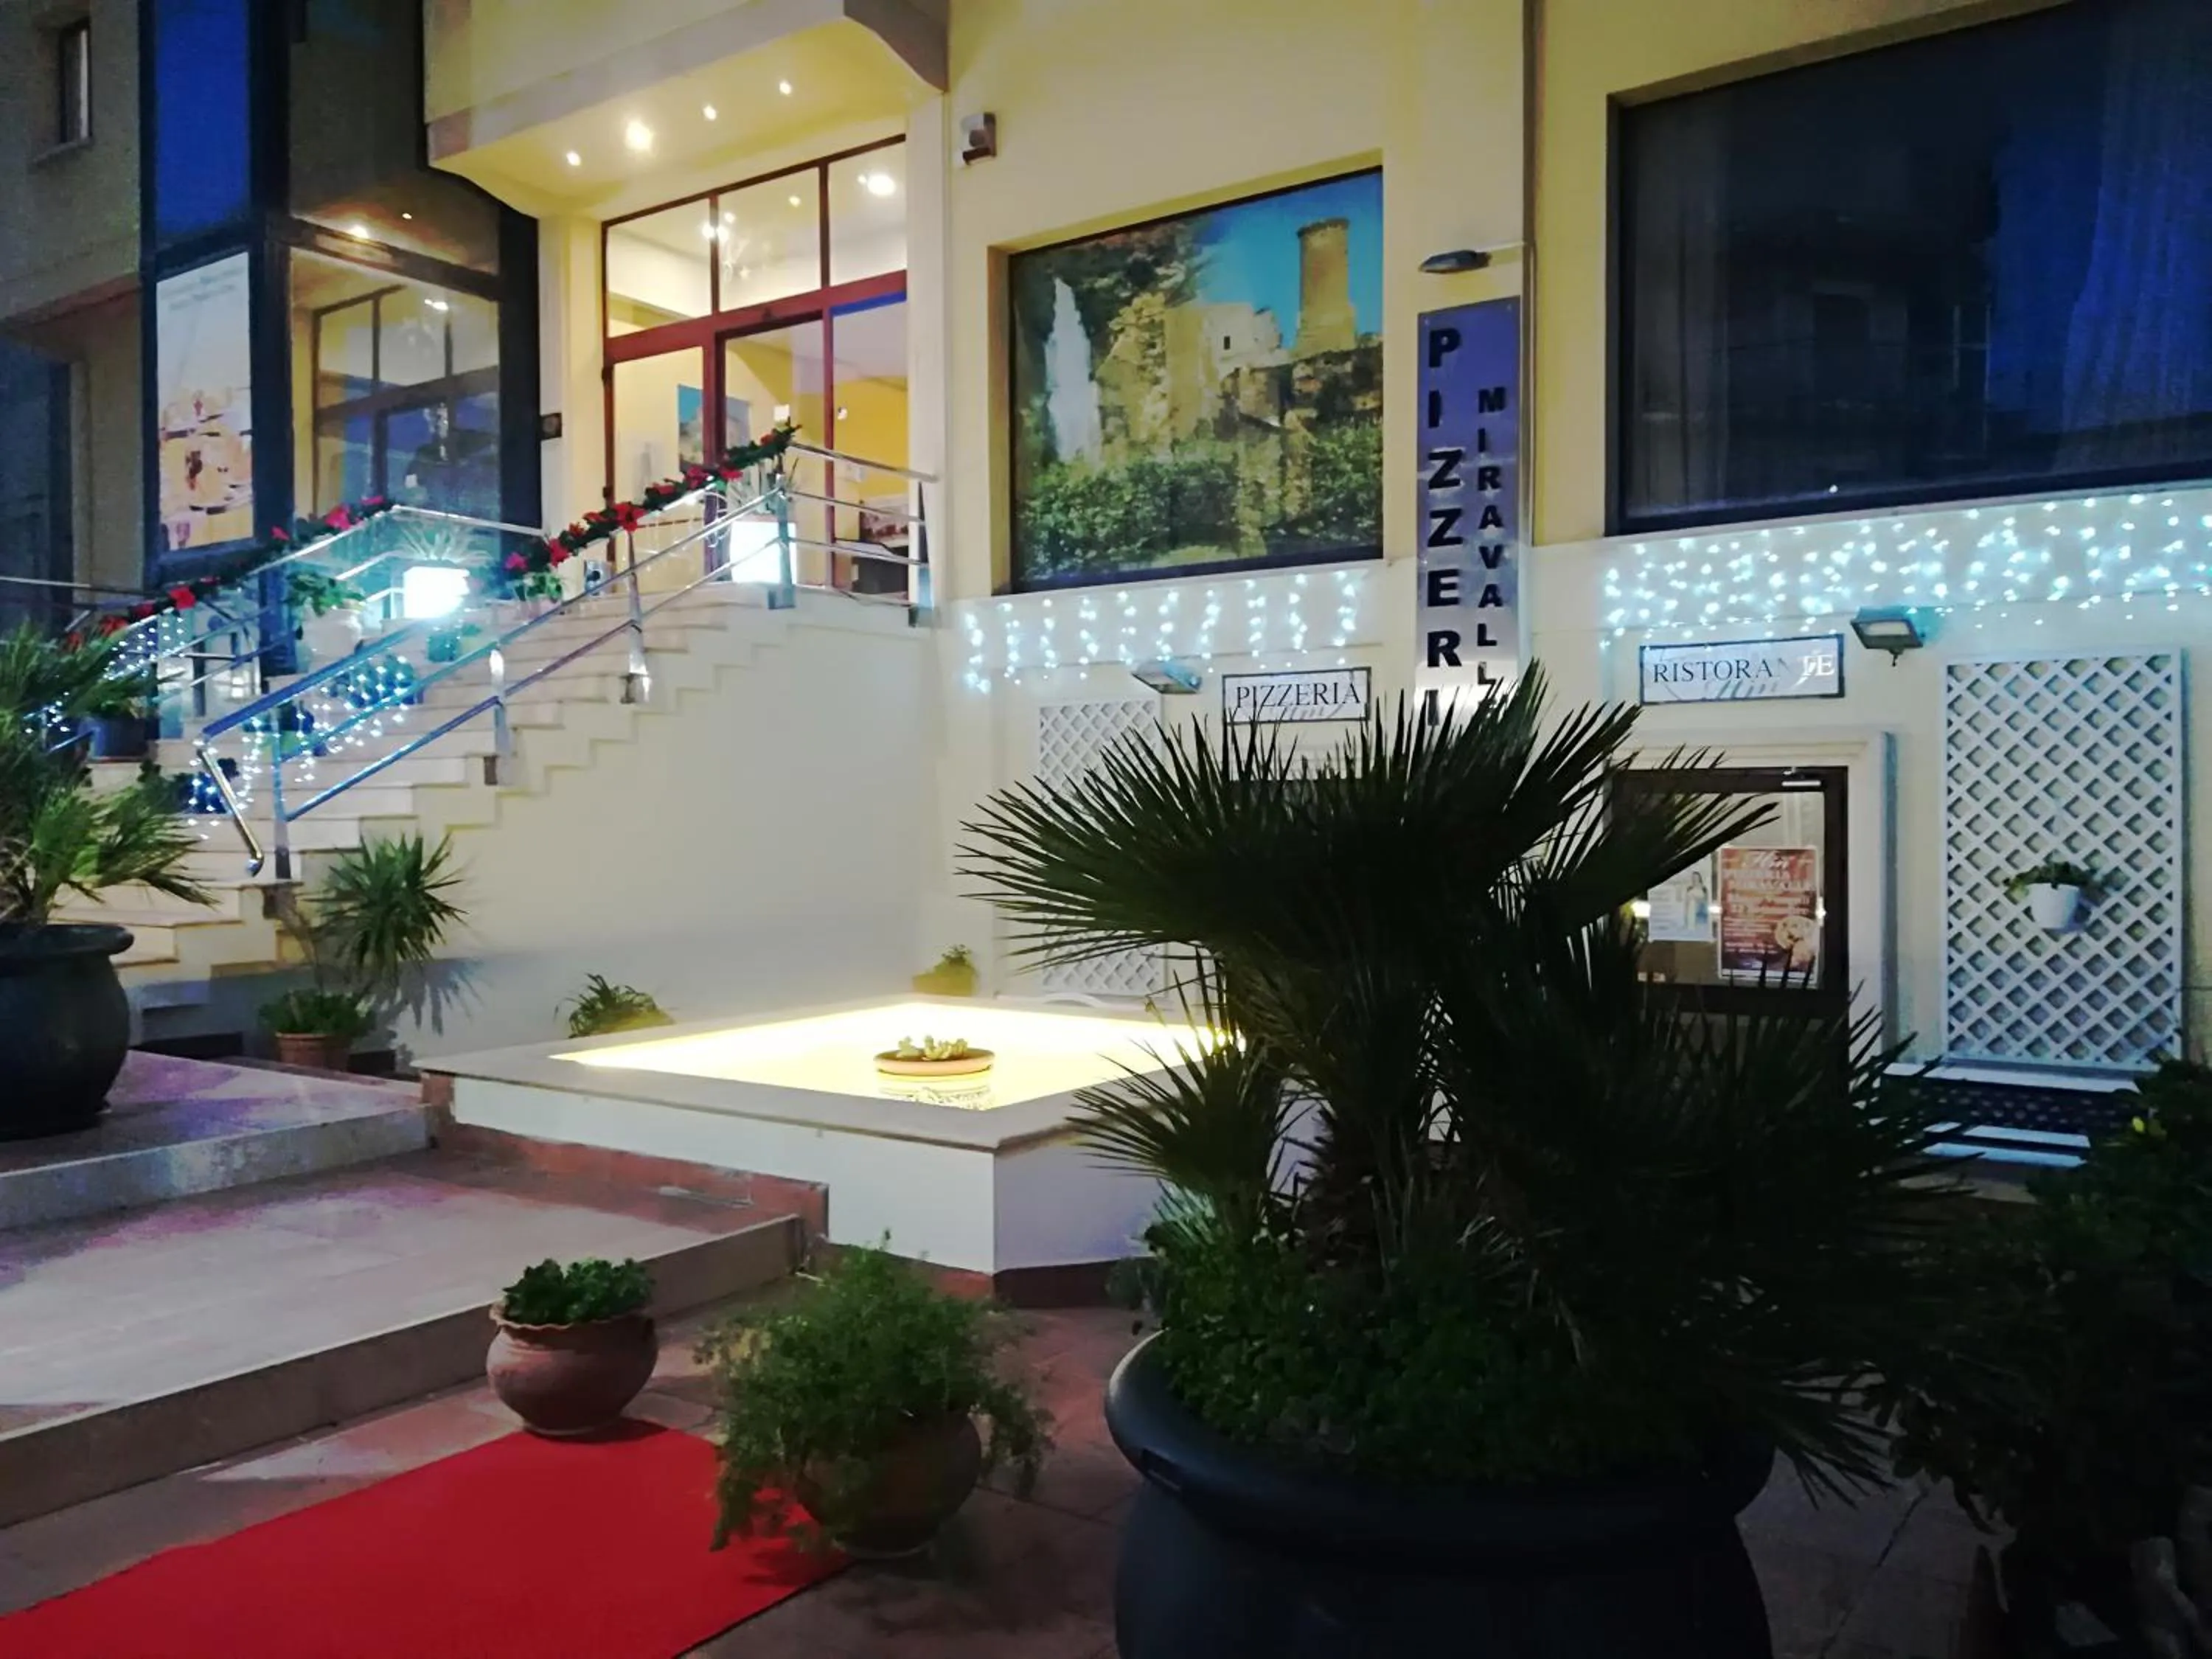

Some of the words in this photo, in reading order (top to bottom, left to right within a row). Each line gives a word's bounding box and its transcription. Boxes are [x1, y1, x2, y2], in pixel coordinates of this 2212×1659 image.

[1427, 327, 1464, 726] PIZZERI
[1476, 386, 1507, 715] MIRAVALL
[1236, 681, 1361, 709] PIZZERIA
